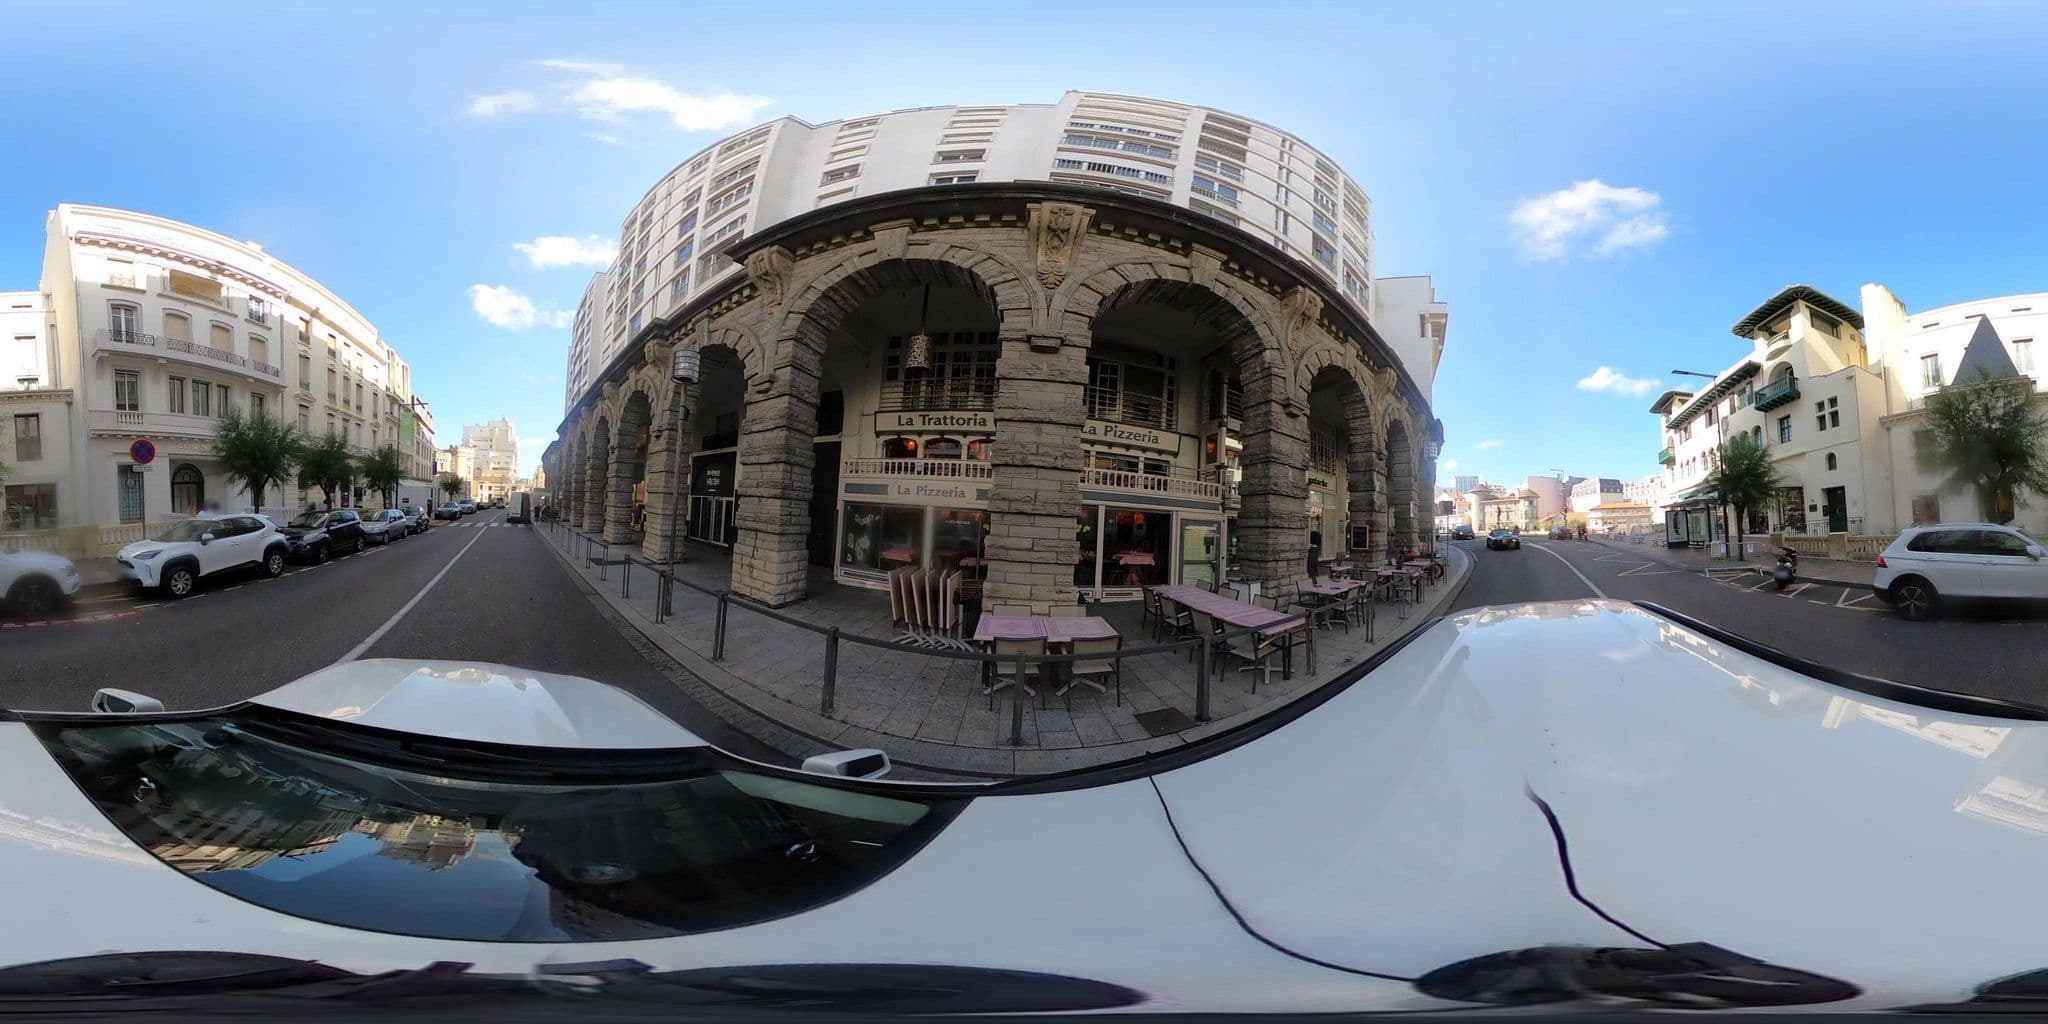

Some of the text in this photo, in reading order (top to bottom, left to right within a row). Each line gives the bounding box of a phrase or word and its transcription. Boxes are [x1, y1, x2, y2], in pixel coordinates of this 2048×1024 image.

[897, 413, 988, 427] La Trattoria
[1080, 424, 1160, 444] La Pizzeria
[897, 485, 966, 499] La Pizzeria
